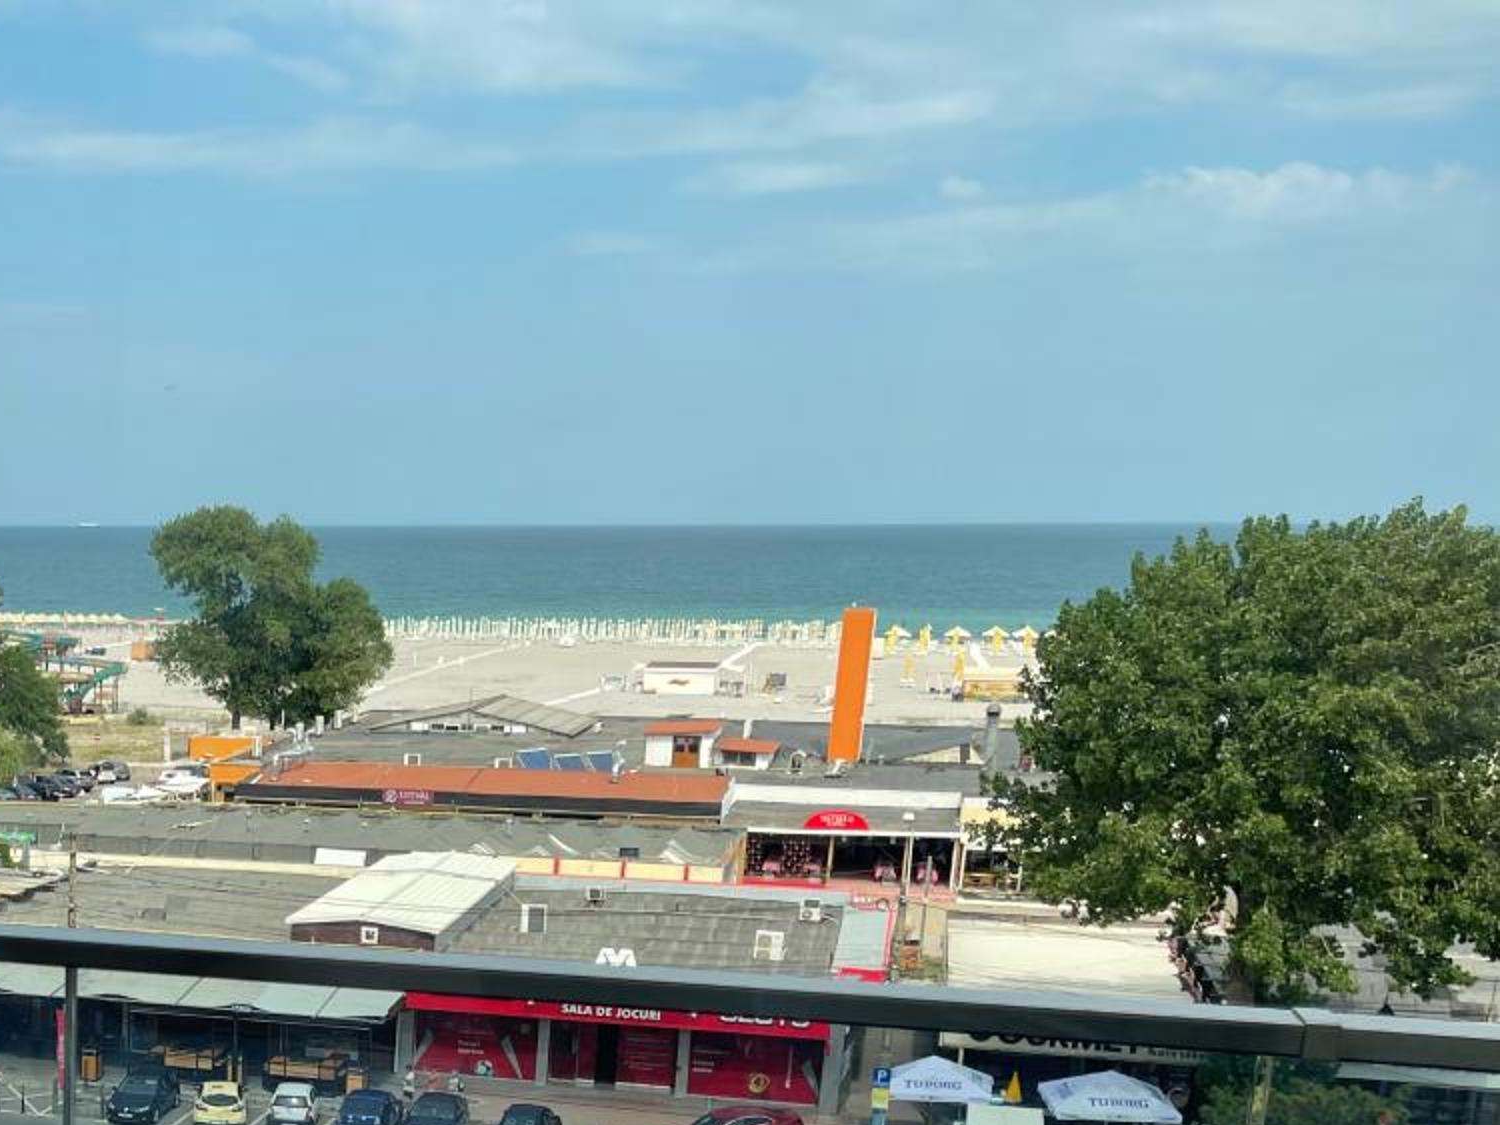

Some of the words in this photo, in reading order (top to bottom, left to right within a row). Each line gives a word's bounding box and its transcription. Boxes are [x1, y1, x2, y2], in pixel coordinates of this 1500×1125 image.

[562, 1003, 593, 1015] SALA
[596, 1005, 613, 1017] DE
[615, 1007, 661, 1021] JOCURI
